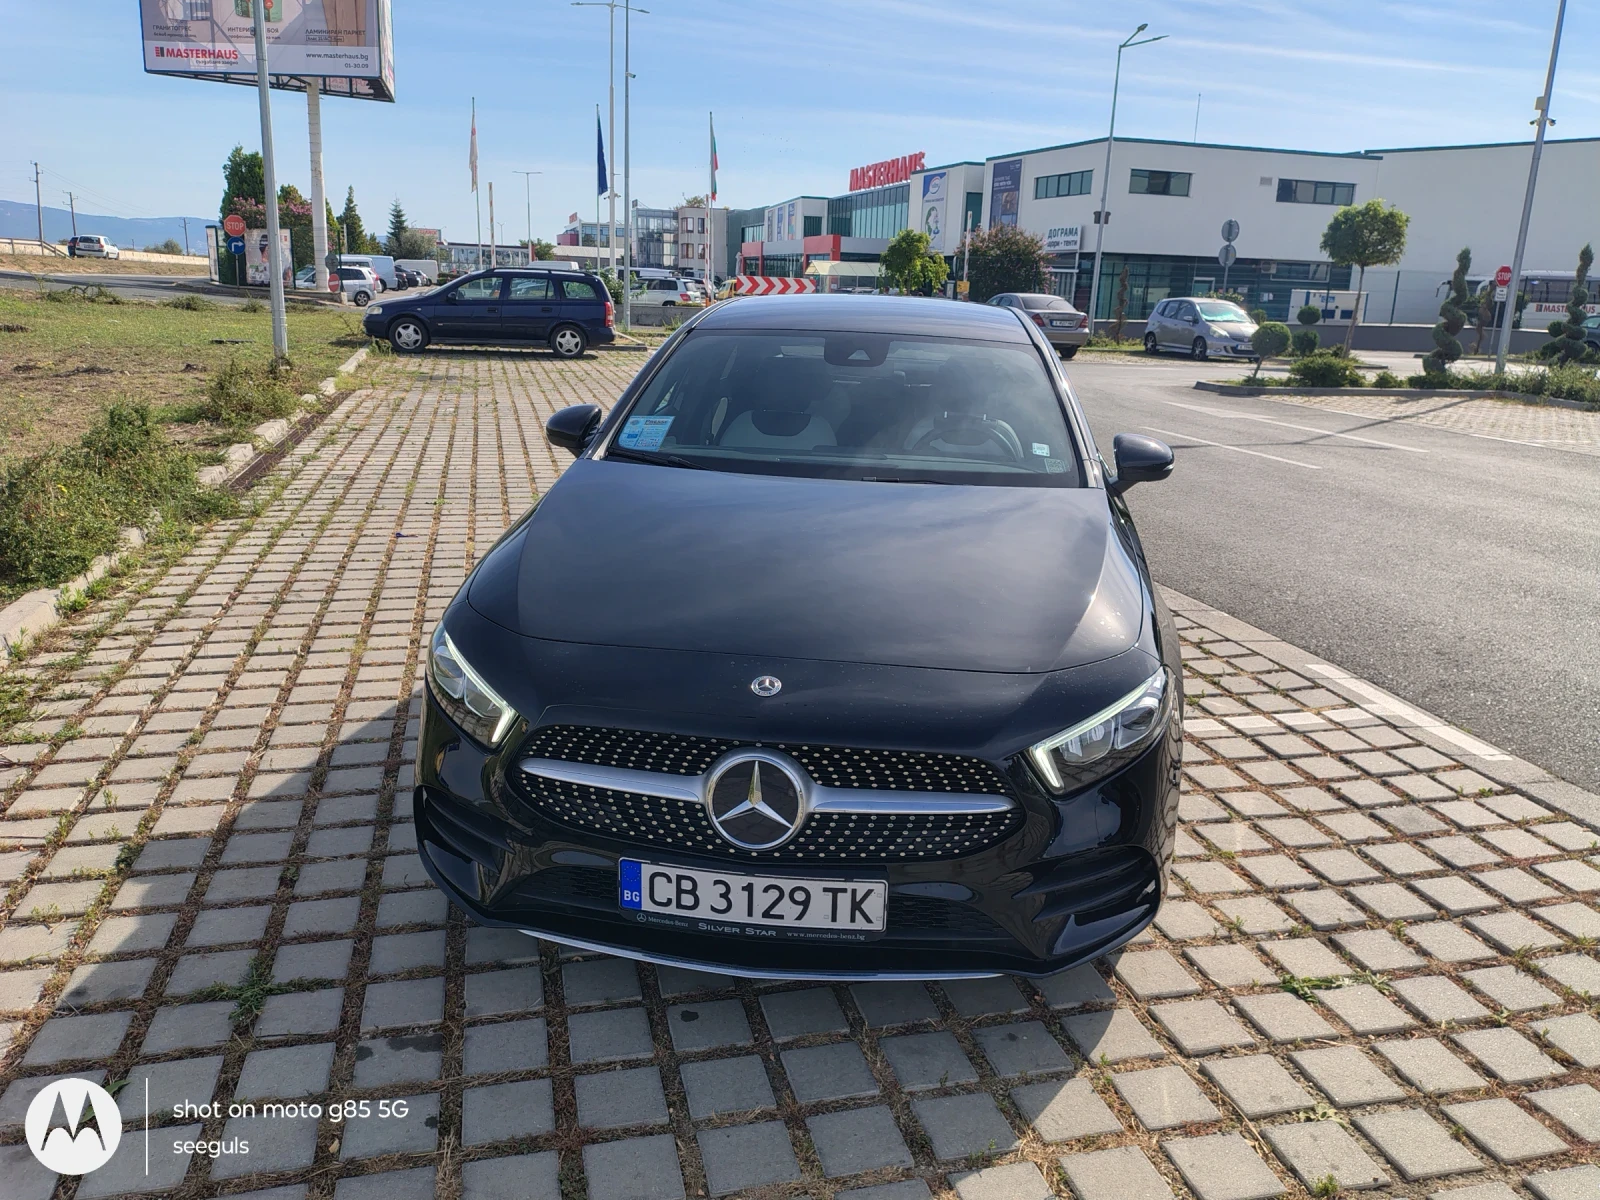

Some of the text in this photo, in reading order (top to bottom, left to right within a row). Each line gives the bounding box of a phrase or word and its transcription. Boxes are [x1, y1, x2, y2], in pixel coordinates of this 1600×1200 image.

[166, 47, 239, 60] MASTERHAUS
[305, 52, 369, 61] www.masterhaus.bg
[849, 151, 926, 192] MASTERHAUS
[226, 221, 244, 231] STOP
[1047, 227, 1079, 240] ДОГРАМА
[1497, 271, 1511, 281] STOP
[623, 889, 640, 902] BG
[648, 871, 875, 924] CB 3129 TK
[698, 922, 777, 937] SILVER STAR
[786, 931, 866, 941] www.mercedes-benz.bg
